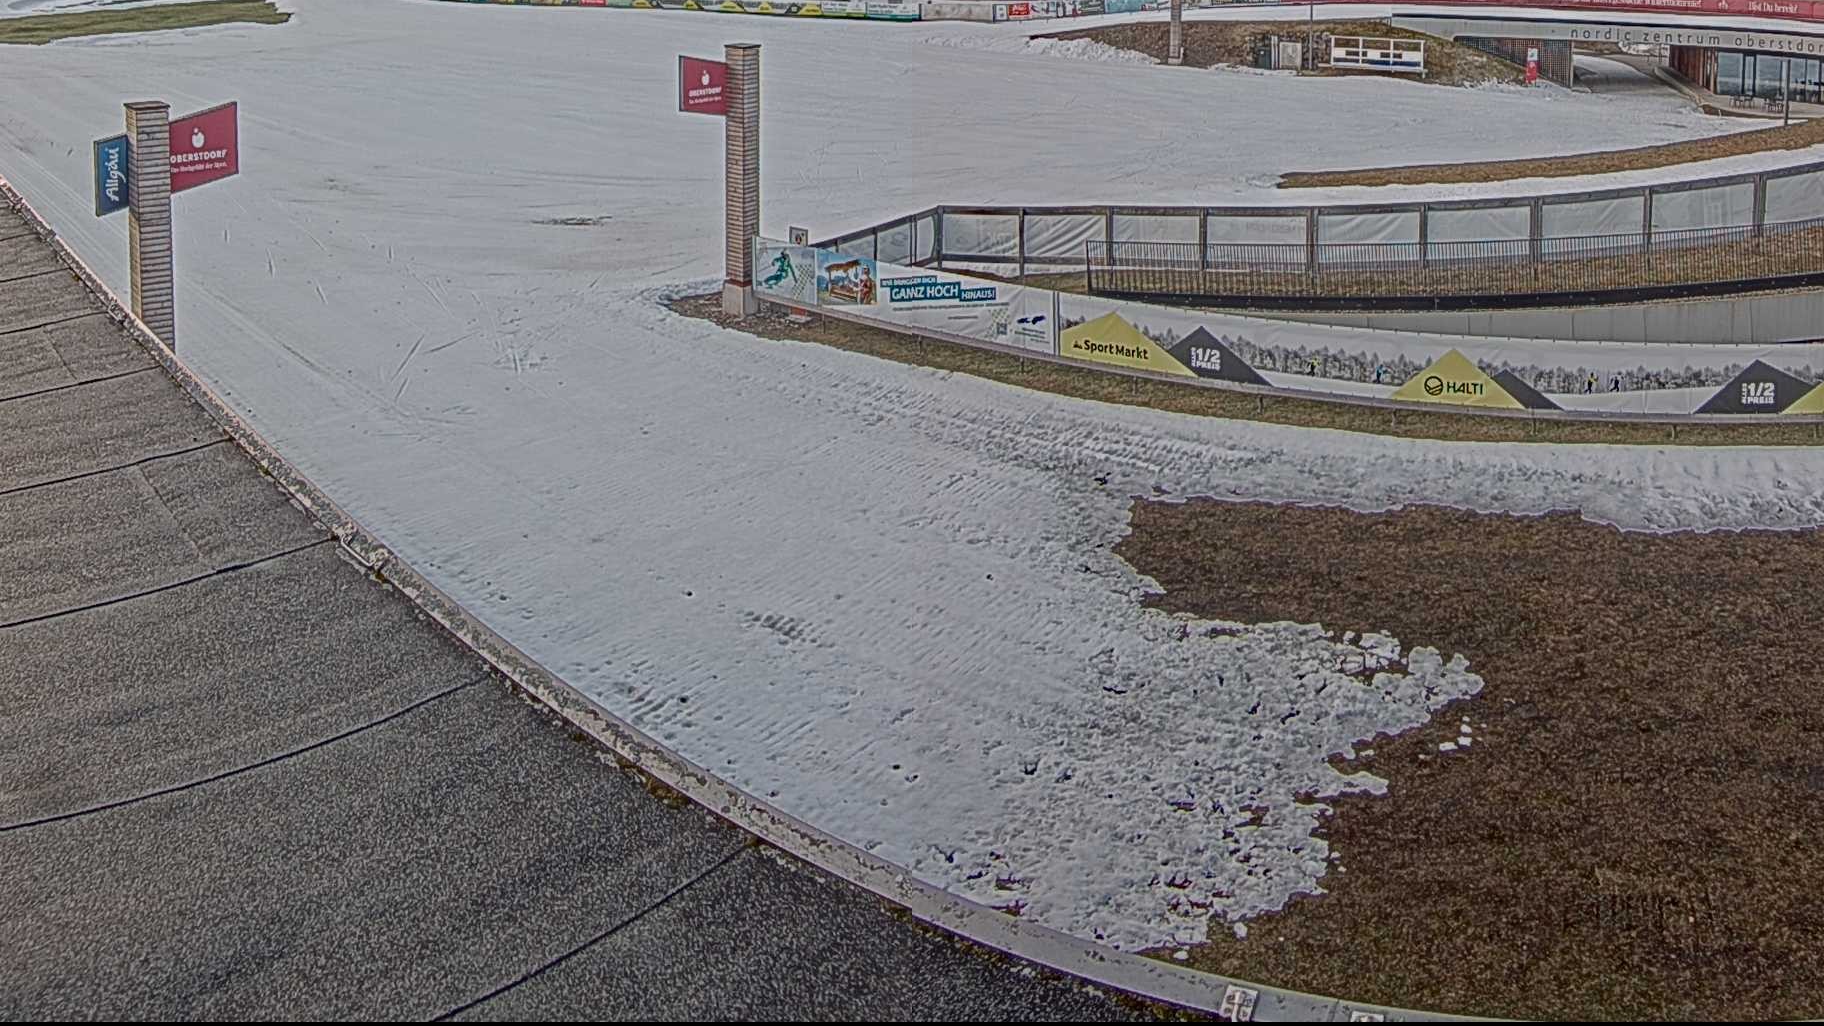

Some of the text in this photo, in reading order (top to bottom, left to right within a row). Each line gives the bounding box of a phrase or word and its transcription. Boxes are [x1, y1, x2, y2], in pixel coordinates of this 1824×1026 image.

[1570, 27, 1631, 42] nordic
[1643, 31, 1721, 46] zentrum
[170, 149, 227, 164] OBERSTDORF
[105, 147, 127, 203] Allgäu
[926, 284, 959, 298] HOCH
[1196, 348, 1220, 363] 1/2
[1446, 381, 1484, 395] HALTI
[1747, 382, 1775, 397] 1/2
